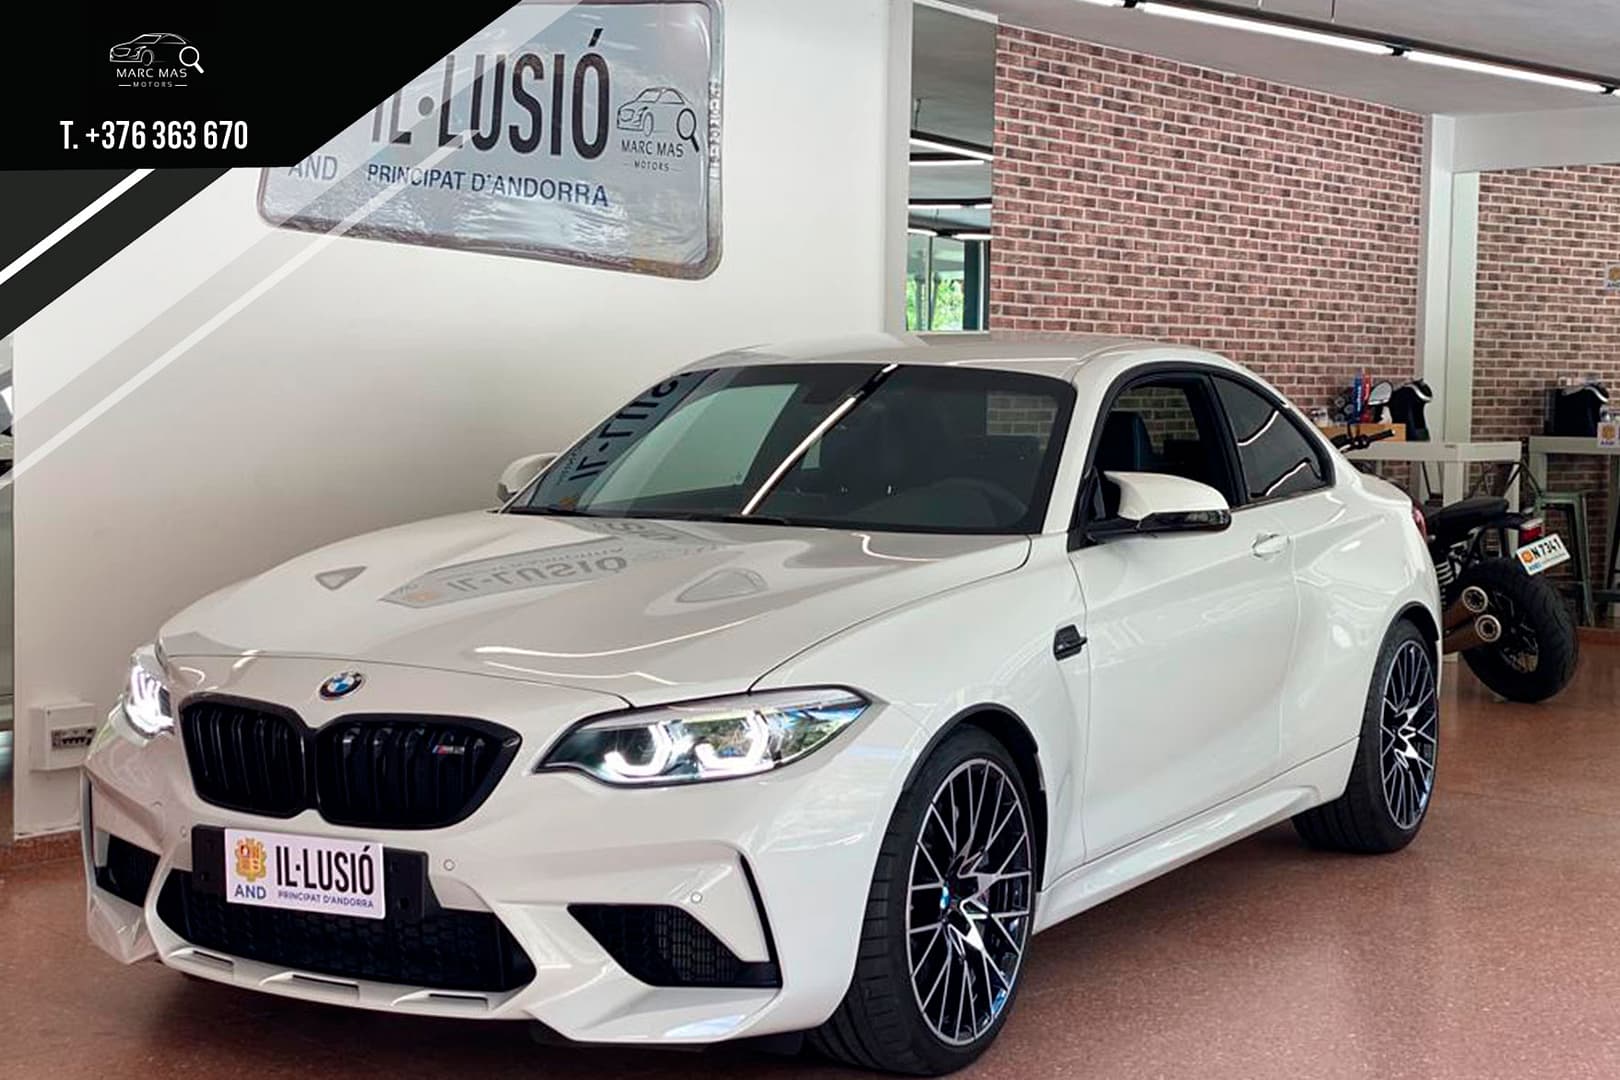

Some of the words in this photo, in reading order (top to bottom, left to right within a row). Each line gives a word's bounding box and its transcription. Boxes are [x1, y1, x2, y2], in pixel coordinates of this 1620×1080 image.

[622, 139, 653, 155] MARC
[657, 142, 684, 158] MAS
[634, 160, 669, 172] MOTORS
[368, 164, 465, 190] PRINCIPAT
[471, 173, 608, 207] D'ANDORRA
[276, 845, 374, 895] IL·LUSIÓ
[234, 884, 267, 899] AND
[278, 891, 321, 902] PRINCIPAT
[323, 895, 374, 908] D'ANDORRA
